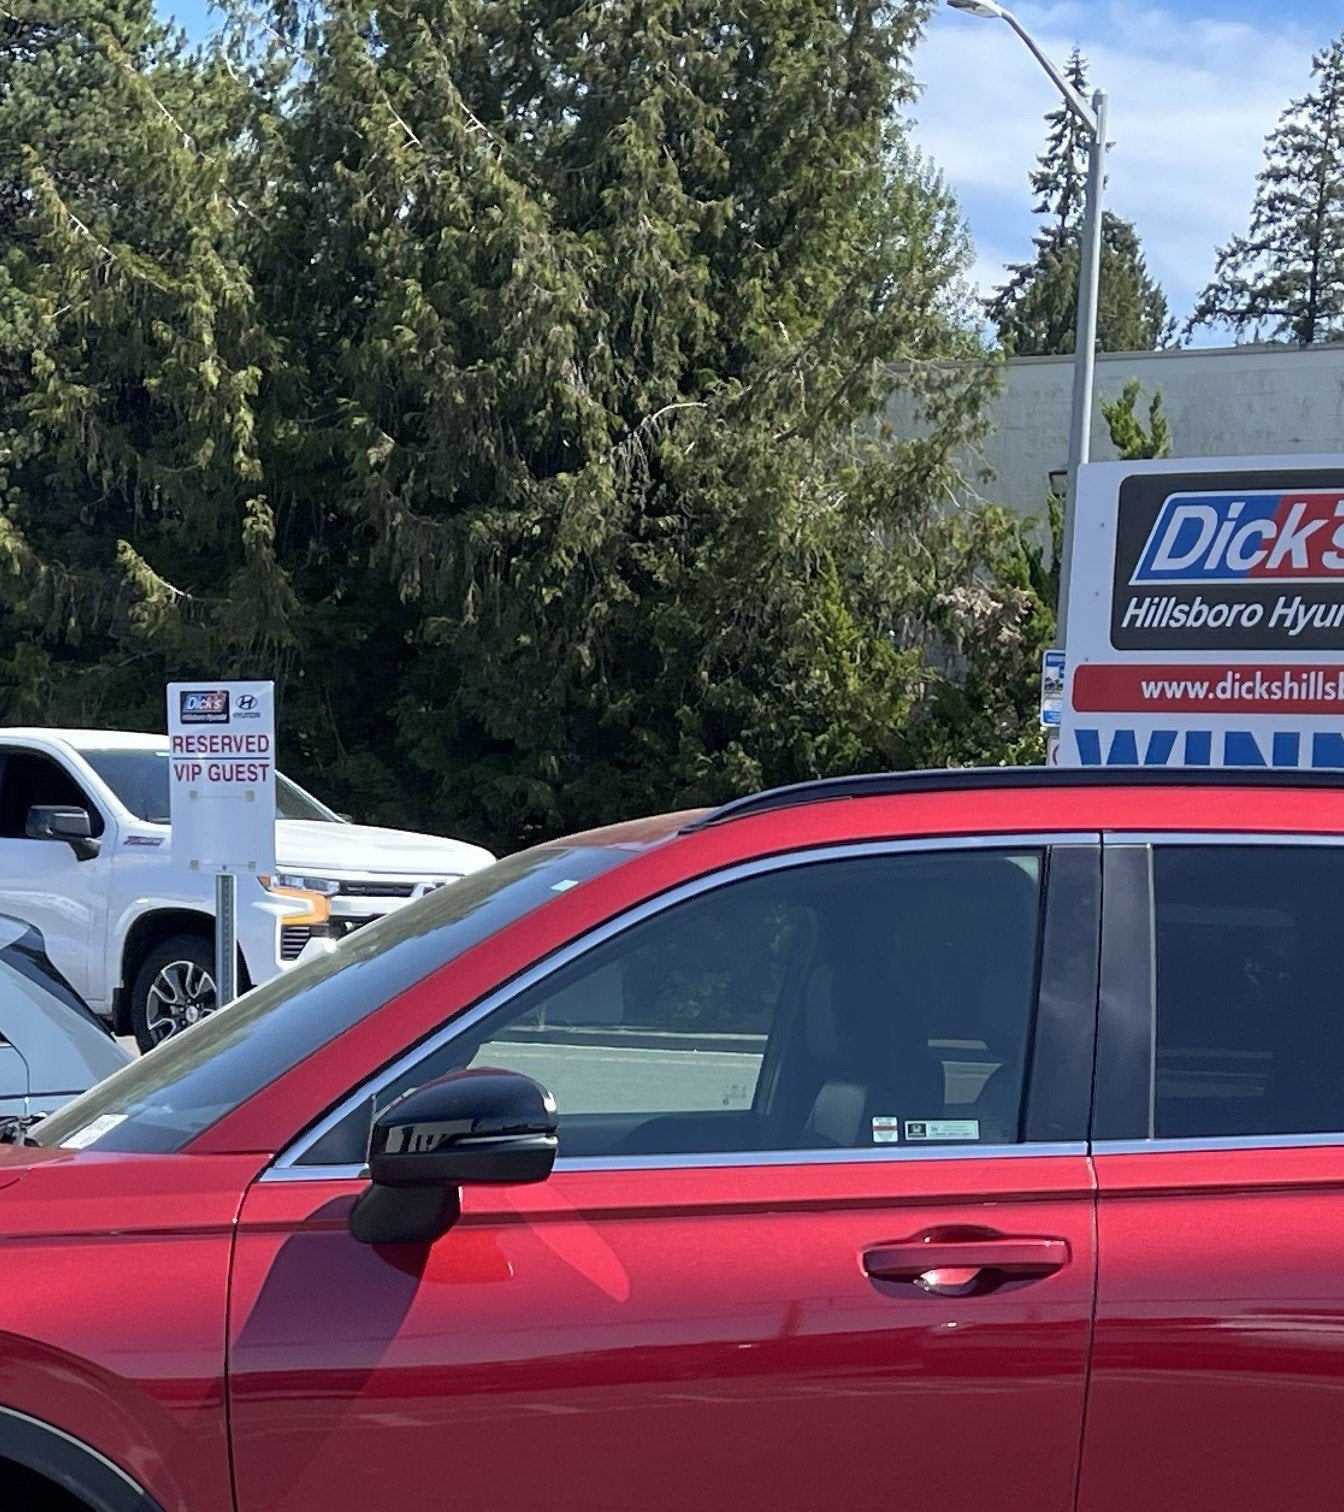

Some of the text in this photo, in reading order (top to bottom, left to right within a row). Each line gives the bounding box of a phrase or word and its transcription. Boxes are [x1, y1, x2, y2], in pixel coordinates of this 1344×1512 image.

[1120, 596, 1265, 629] Hillsboro
[172, 735, 270, 753] RESERVED
[173, 763, 270, 782] VIP GUEST
